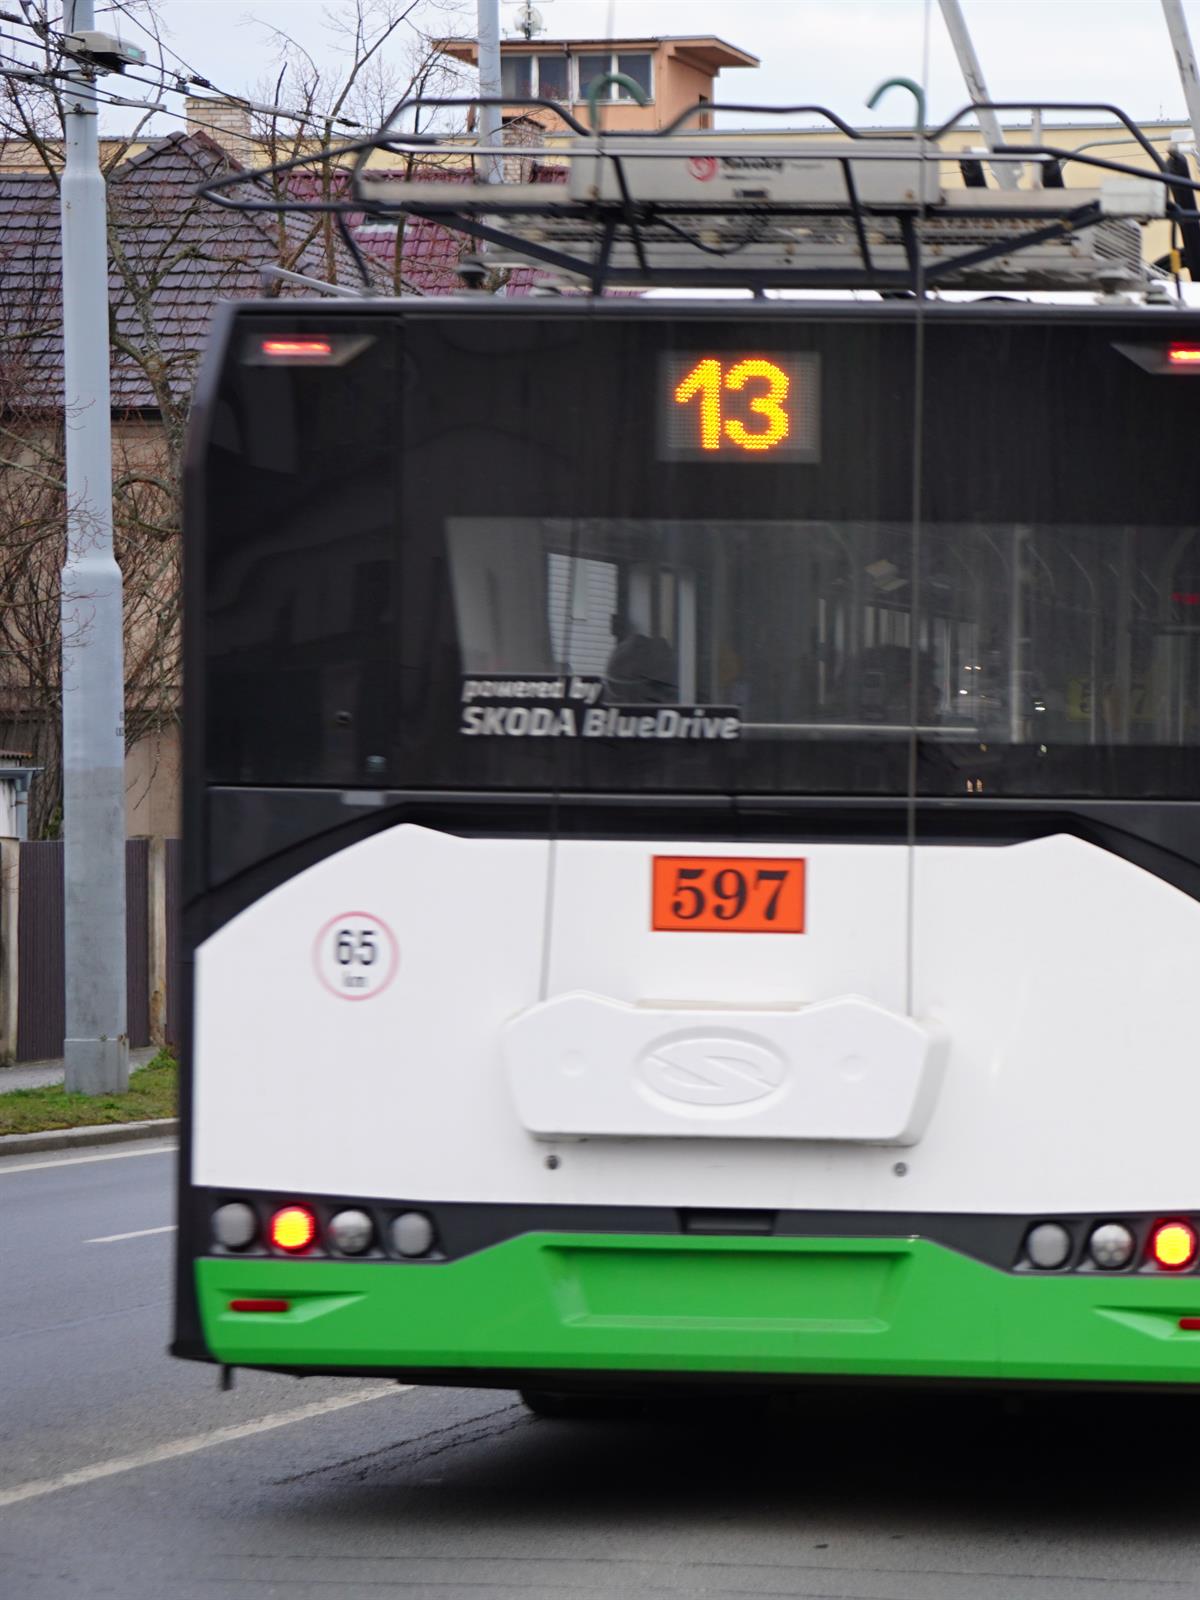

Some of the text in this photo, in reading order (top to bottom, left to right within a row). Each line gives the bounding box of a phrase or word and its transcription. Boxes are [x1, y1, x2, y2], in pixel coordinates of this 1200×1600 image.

[674, 359, 790, 450] 13
[462, 677, 603, 704] powered by
[582, 707, 740, 739] BlueDrive
[671, 868, 790, 922] 597
[335, 929, 378, 966] 65
